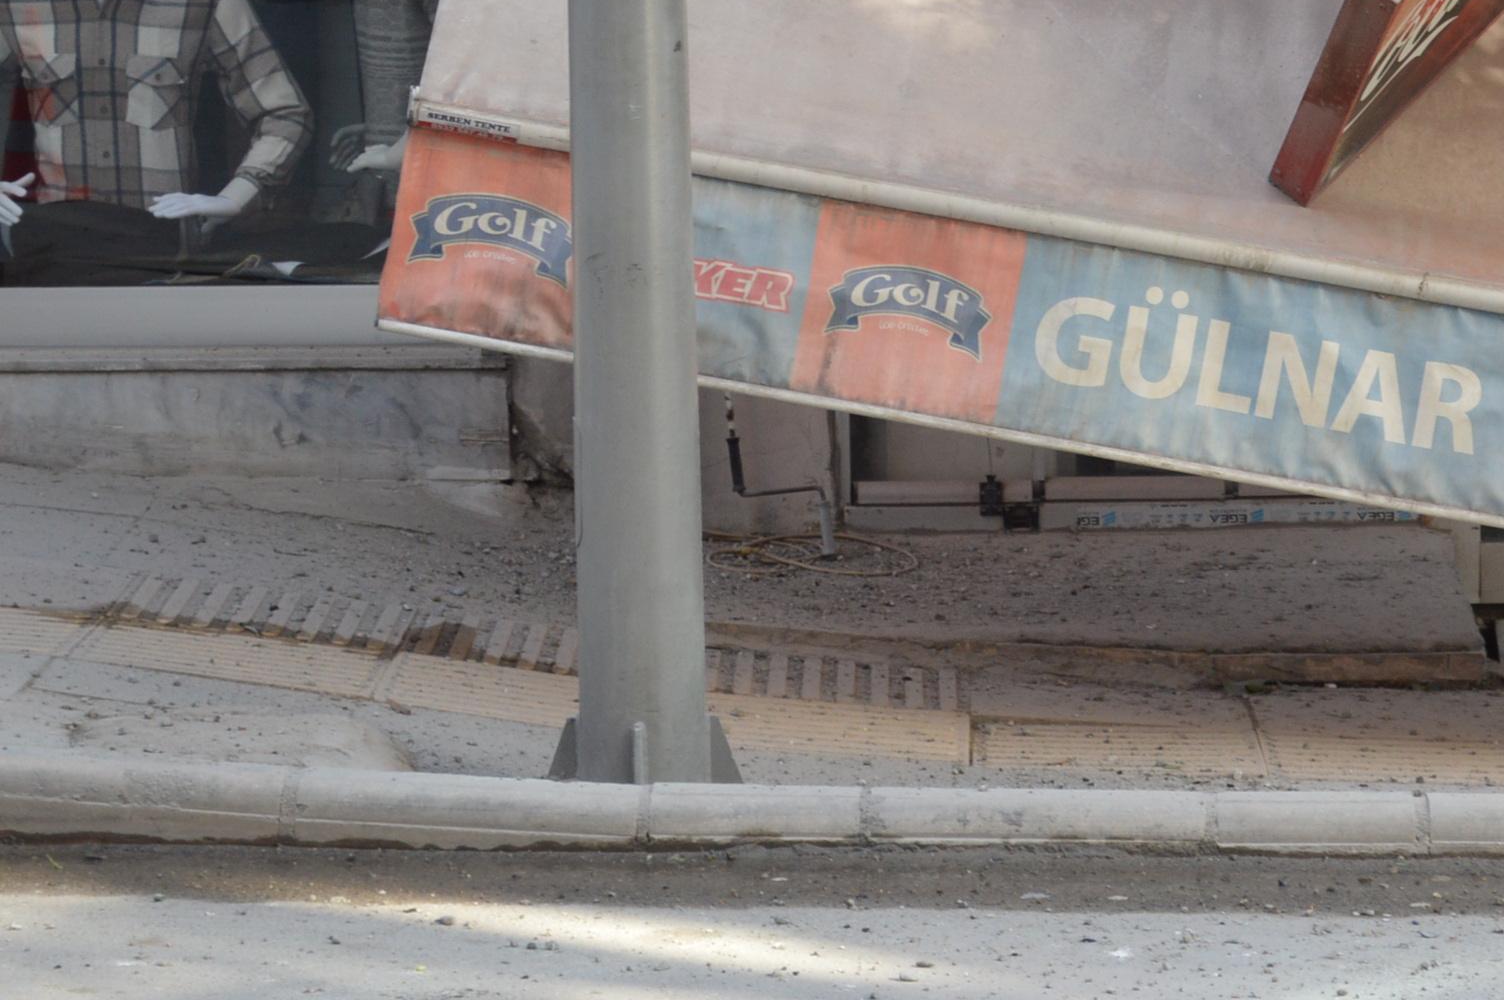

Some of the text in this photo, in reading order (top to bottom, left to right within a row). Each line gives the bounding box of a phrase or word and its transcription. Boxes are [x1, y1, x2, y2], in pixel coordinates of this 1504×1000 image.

[433, 202, 556, 252] Golf
[850, 273, 968, 322] Golf
[1033, 285, 1484, 456] GÜLNAR
[1209, 513, 1248, 525] EGEA
[1356, 510, 1395, 522] EGEA
